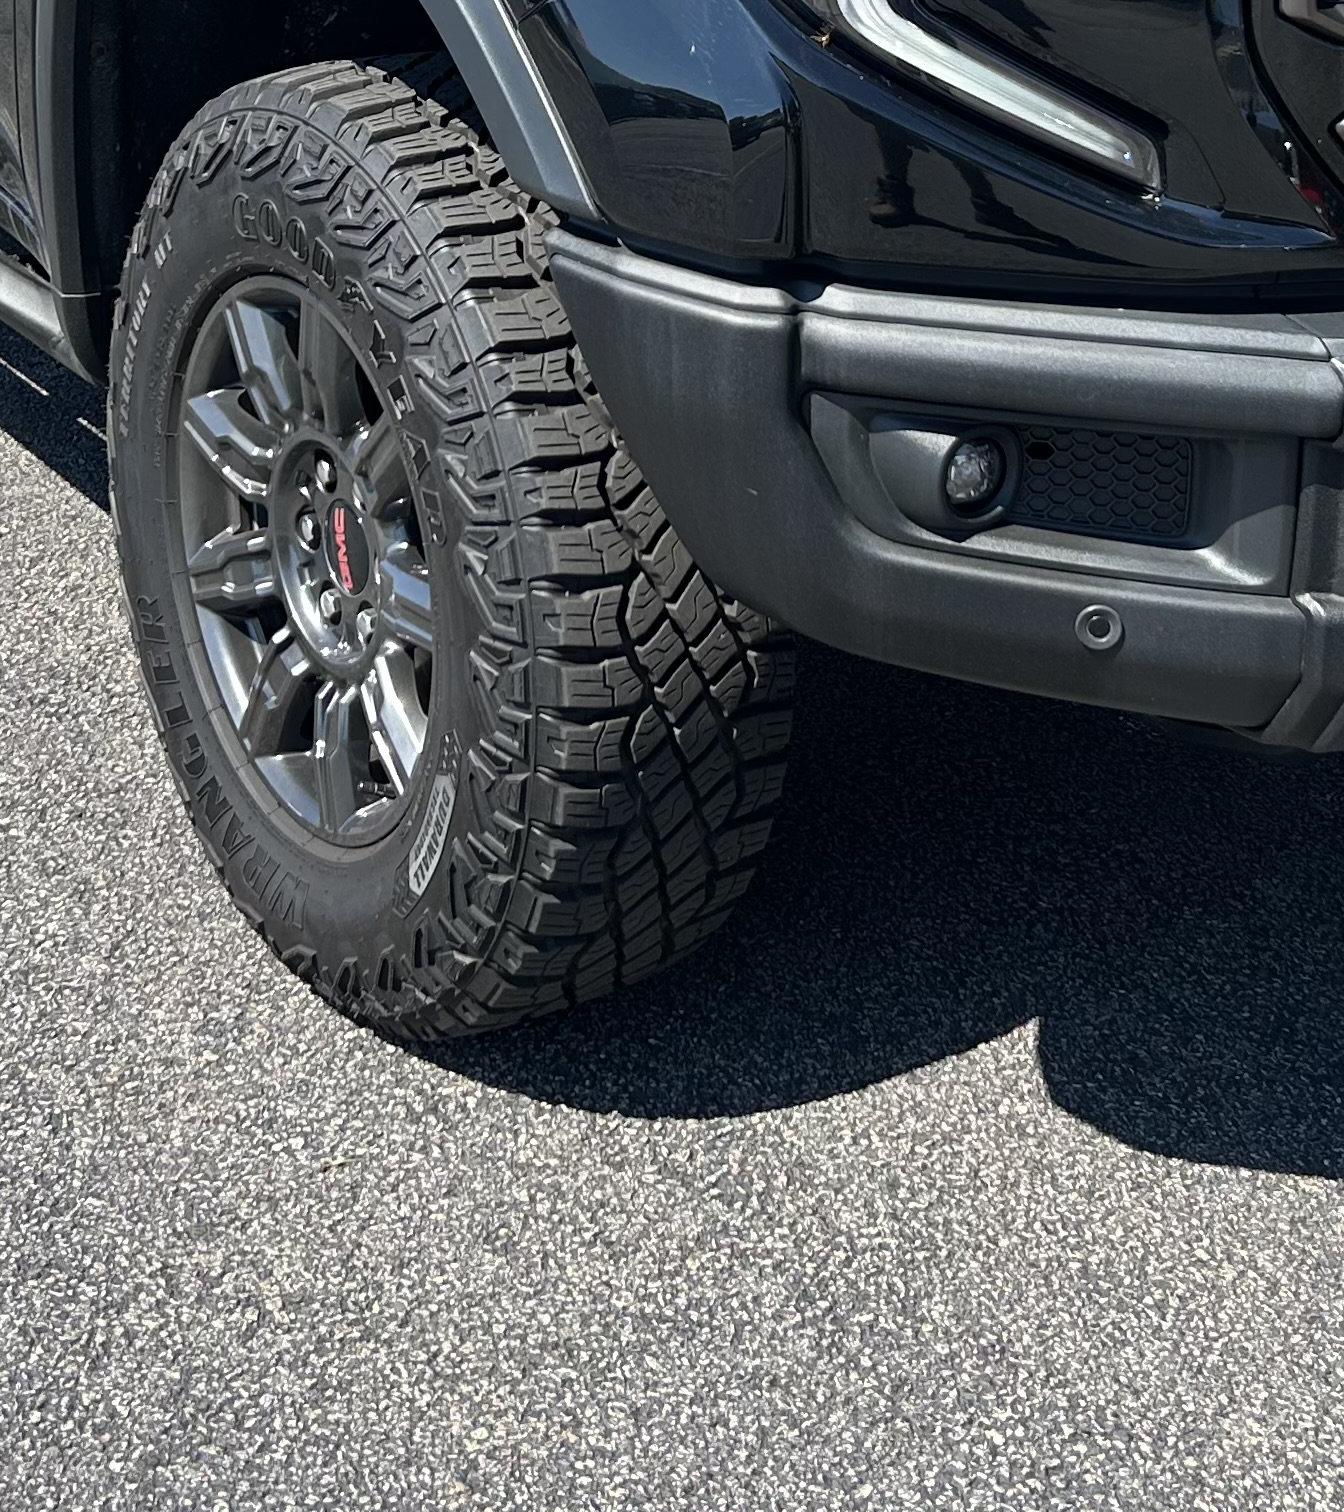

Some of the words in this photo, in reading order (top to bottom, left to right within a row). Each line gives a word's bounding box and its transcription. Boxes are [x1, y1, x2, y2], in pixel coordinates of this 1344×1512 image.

[334, 507, 353, 589] GMC
[135, 595, 312, 931] WRANGLER
[413, 785, 451, 889] DURAWALL
